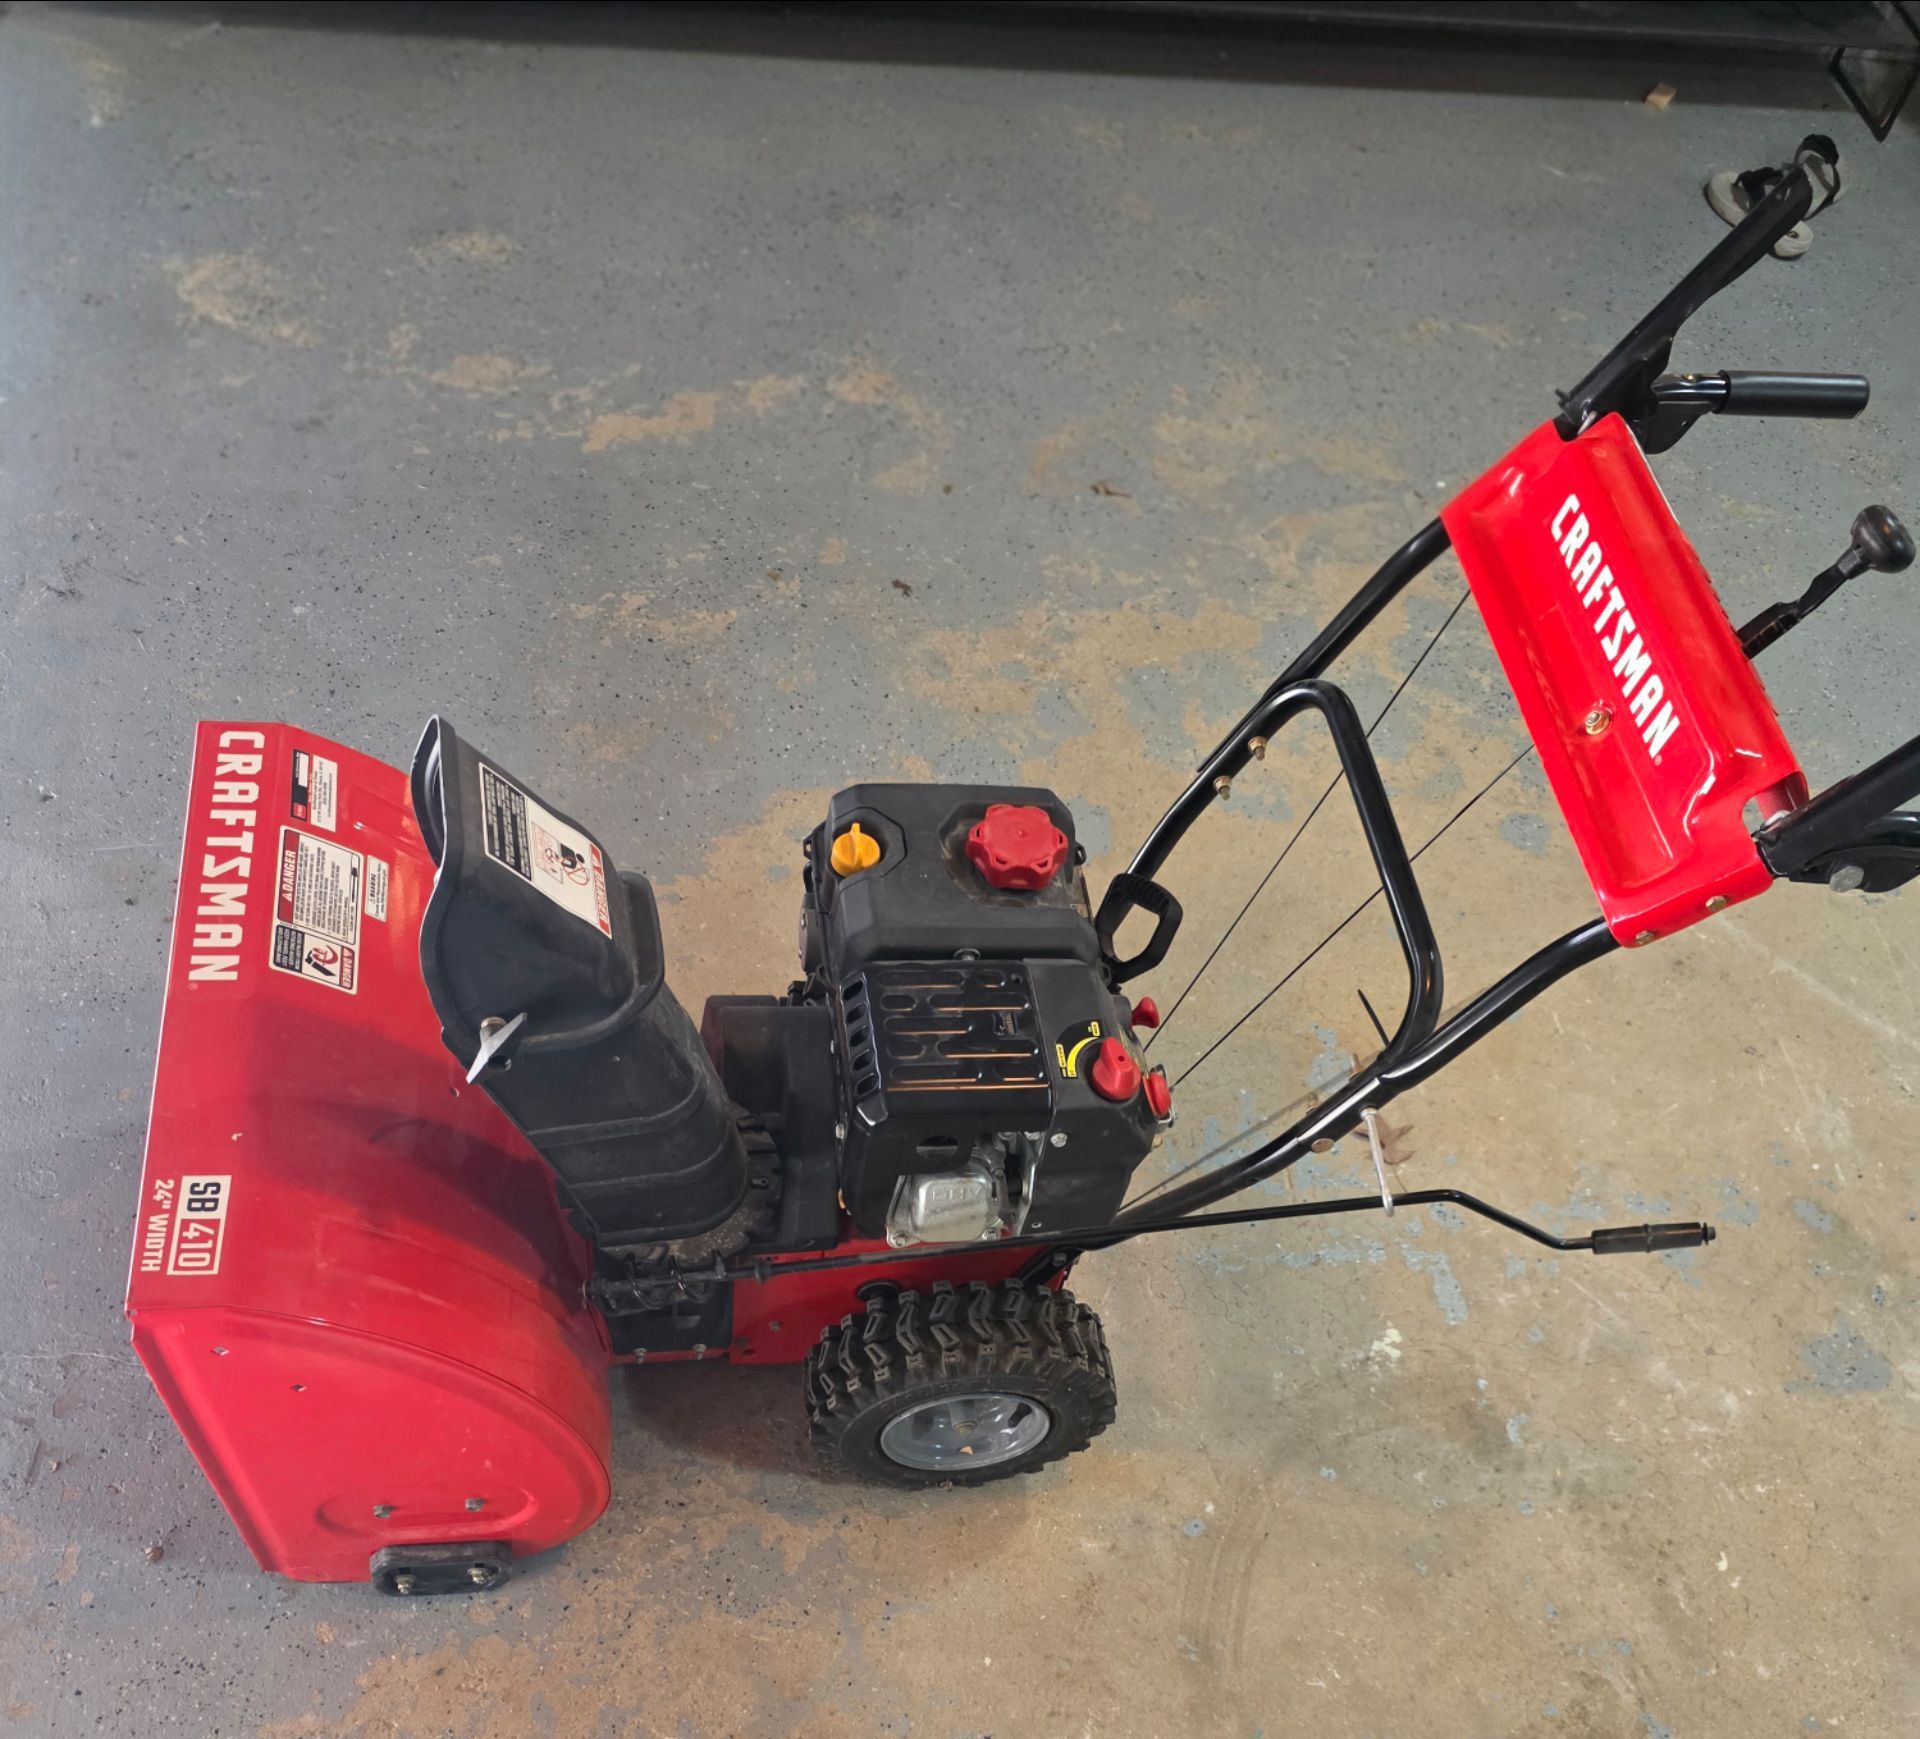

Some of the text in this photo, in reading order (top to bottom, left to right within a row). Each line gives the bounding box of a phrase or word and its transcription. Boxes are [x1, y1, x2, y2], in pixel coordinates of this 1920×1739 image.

[1550, 493, 1680, 759] CRAFTSMAN
[189, 730, 266, 981] CRAFTSMAN
[281, 850, 297, 891] DANGER
[594, 872, 609, 923] DANGER
[140, 1179, 175, 1272] 24" WIDTH
[178, 1182, 221, 1268] SB 410
